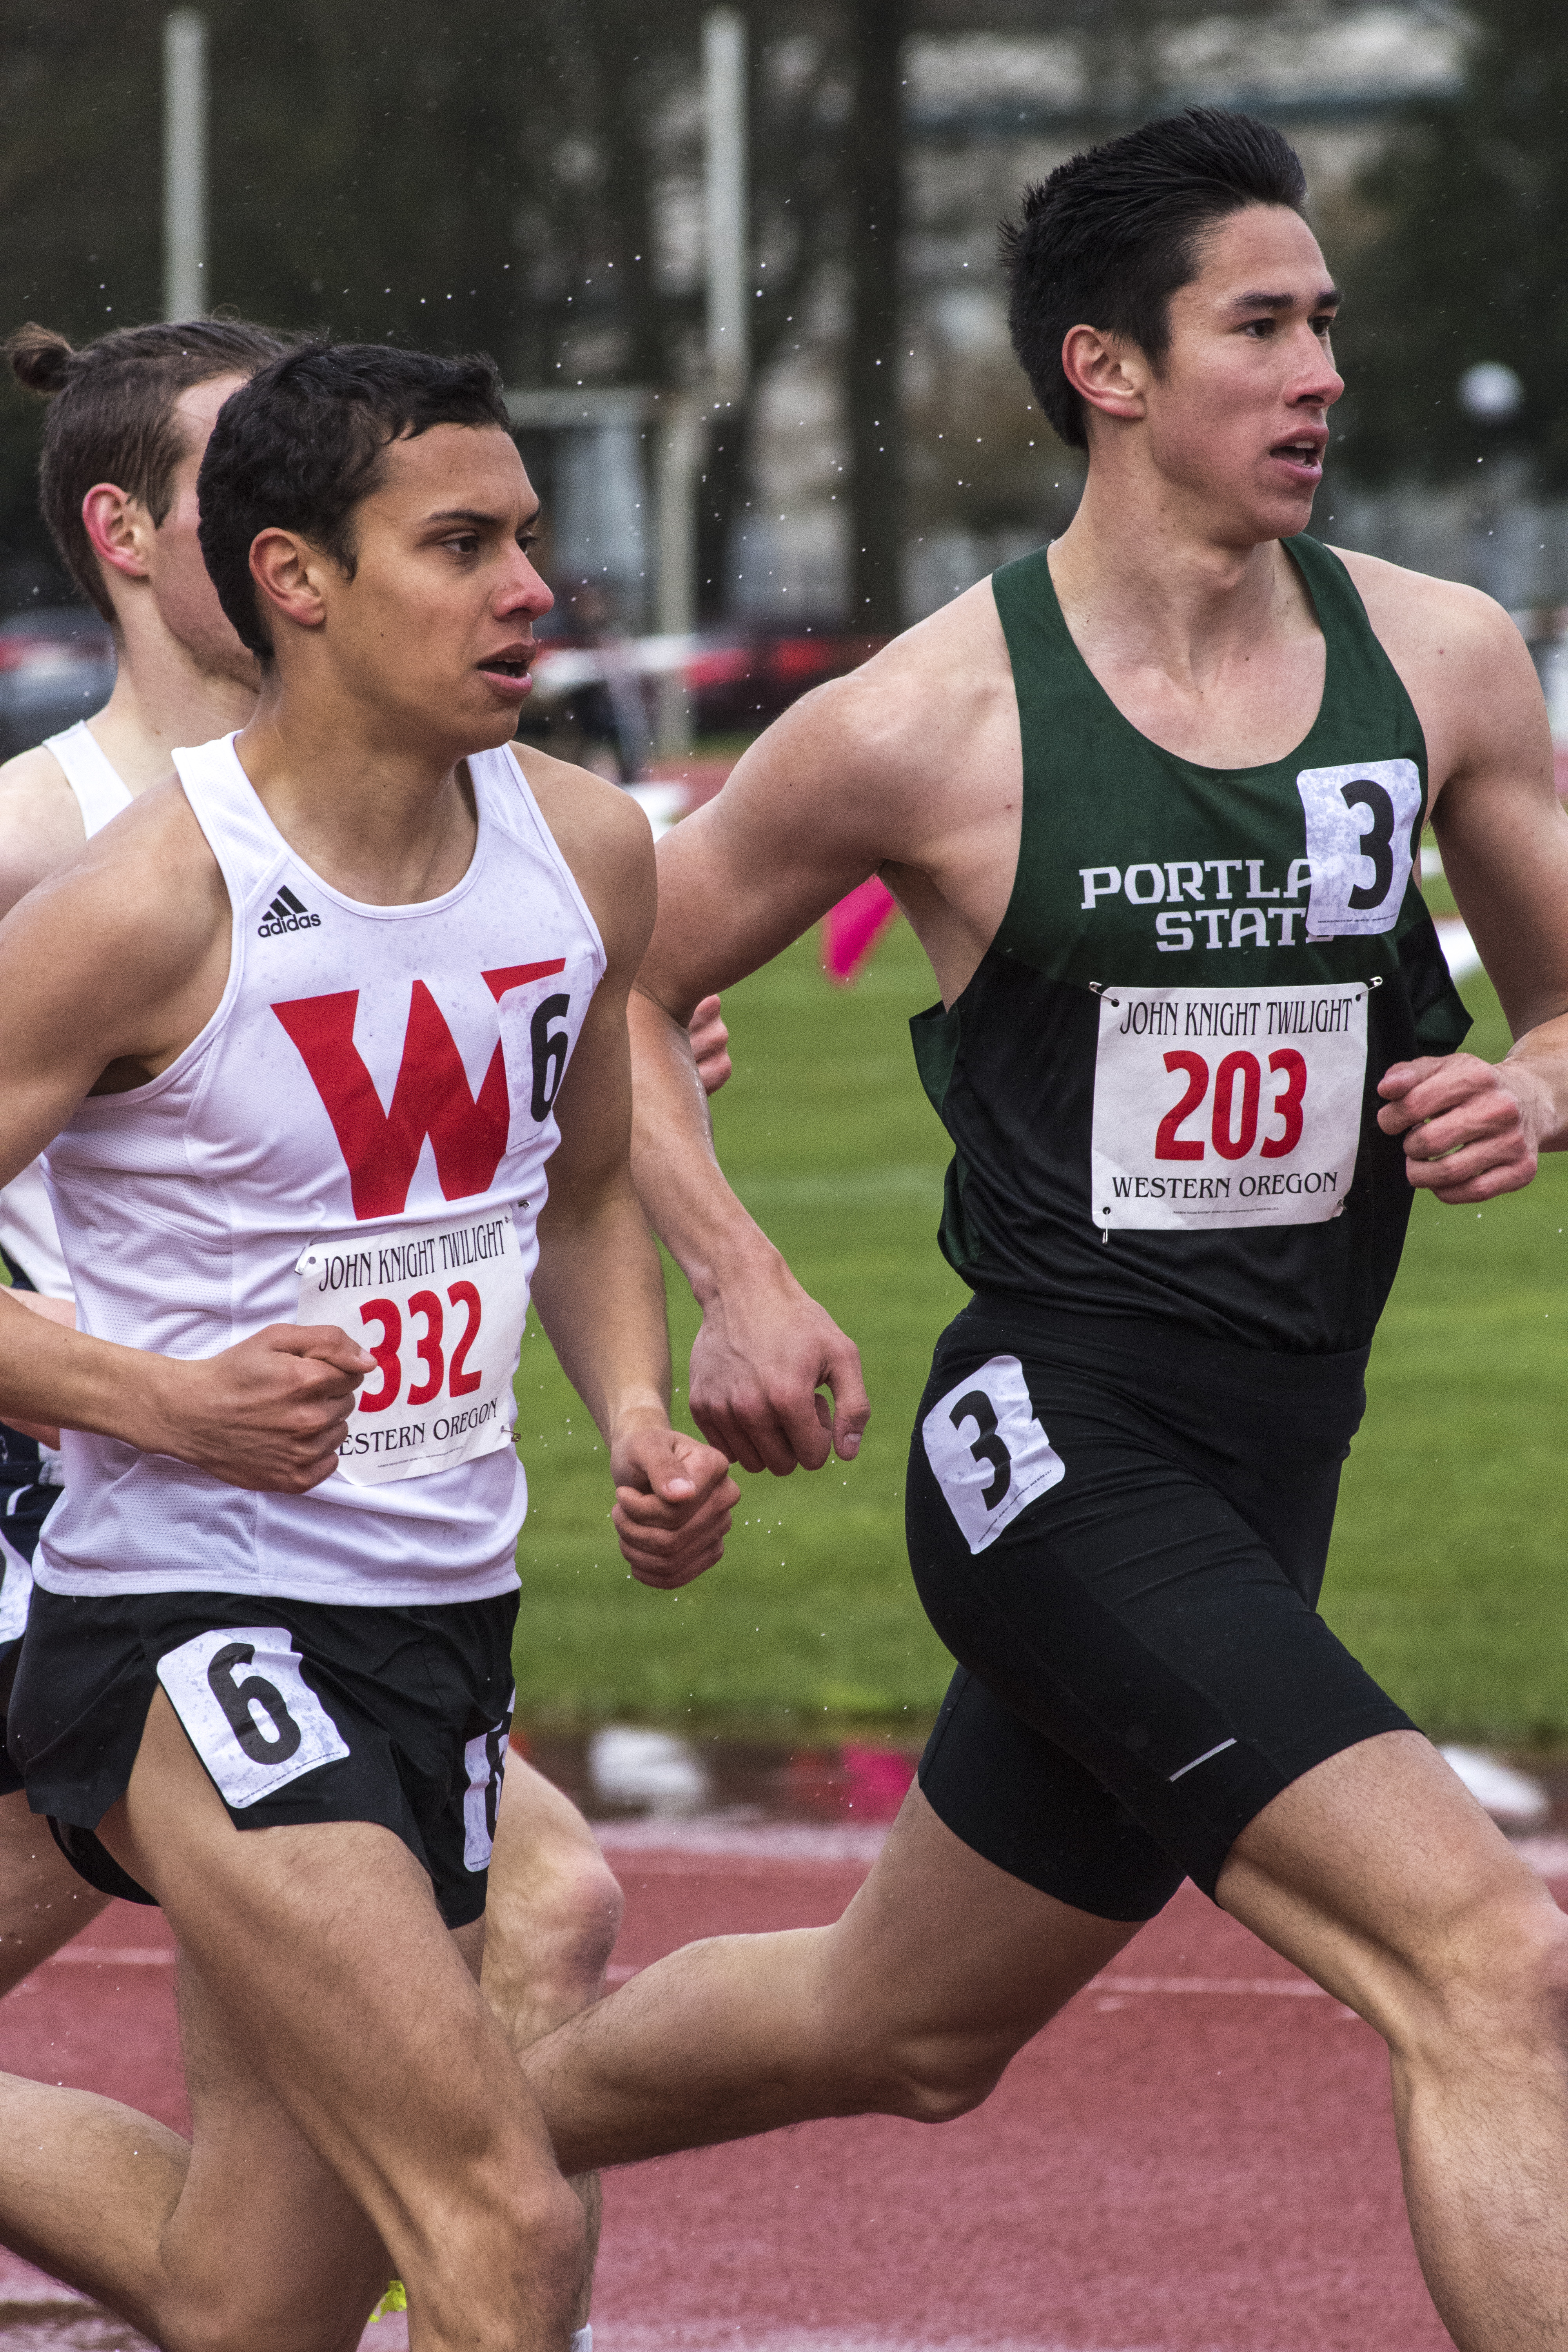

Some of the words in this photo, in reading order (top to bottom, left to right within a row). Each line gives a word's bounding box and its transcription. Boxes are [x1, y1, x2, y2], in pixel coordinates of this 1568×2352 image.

[1079, 858, 1312, 909] PORTLA
[1340, 779, 1395, 910] 3
[257, 912, 321, 938] adidas
[1155, 907, 1334, 952] STAT
[530, 993, 570, 1122] 6
[1120, 1002, 1179, 1035] JOHN
[1184, 1002, 1261, 1036] KNIGHT
[1265, 998, 1353, 1035] TWILIGHT
[269, 957, 566, 1221] W
[1155, 1048, 1307, 1161] 203
[1112, 1176, 1231, 1198] WESTERN
[1239, 1171, 1338, 1197] OREGON
[318, 1252, 372, 1292] JOHN
[378, 1239, 436, 1284] KNIGHT
[439, 1220, 506, 1270] TWILIGHT
[358, 1280, 482, 1413] 332
[338, 1423, 425, 1456] ESTERN
[433, 1397, 498, 1440] OREGON
[948, 1389, 1012, 1512] 3
[207, 1642, 301, 1766] 6
